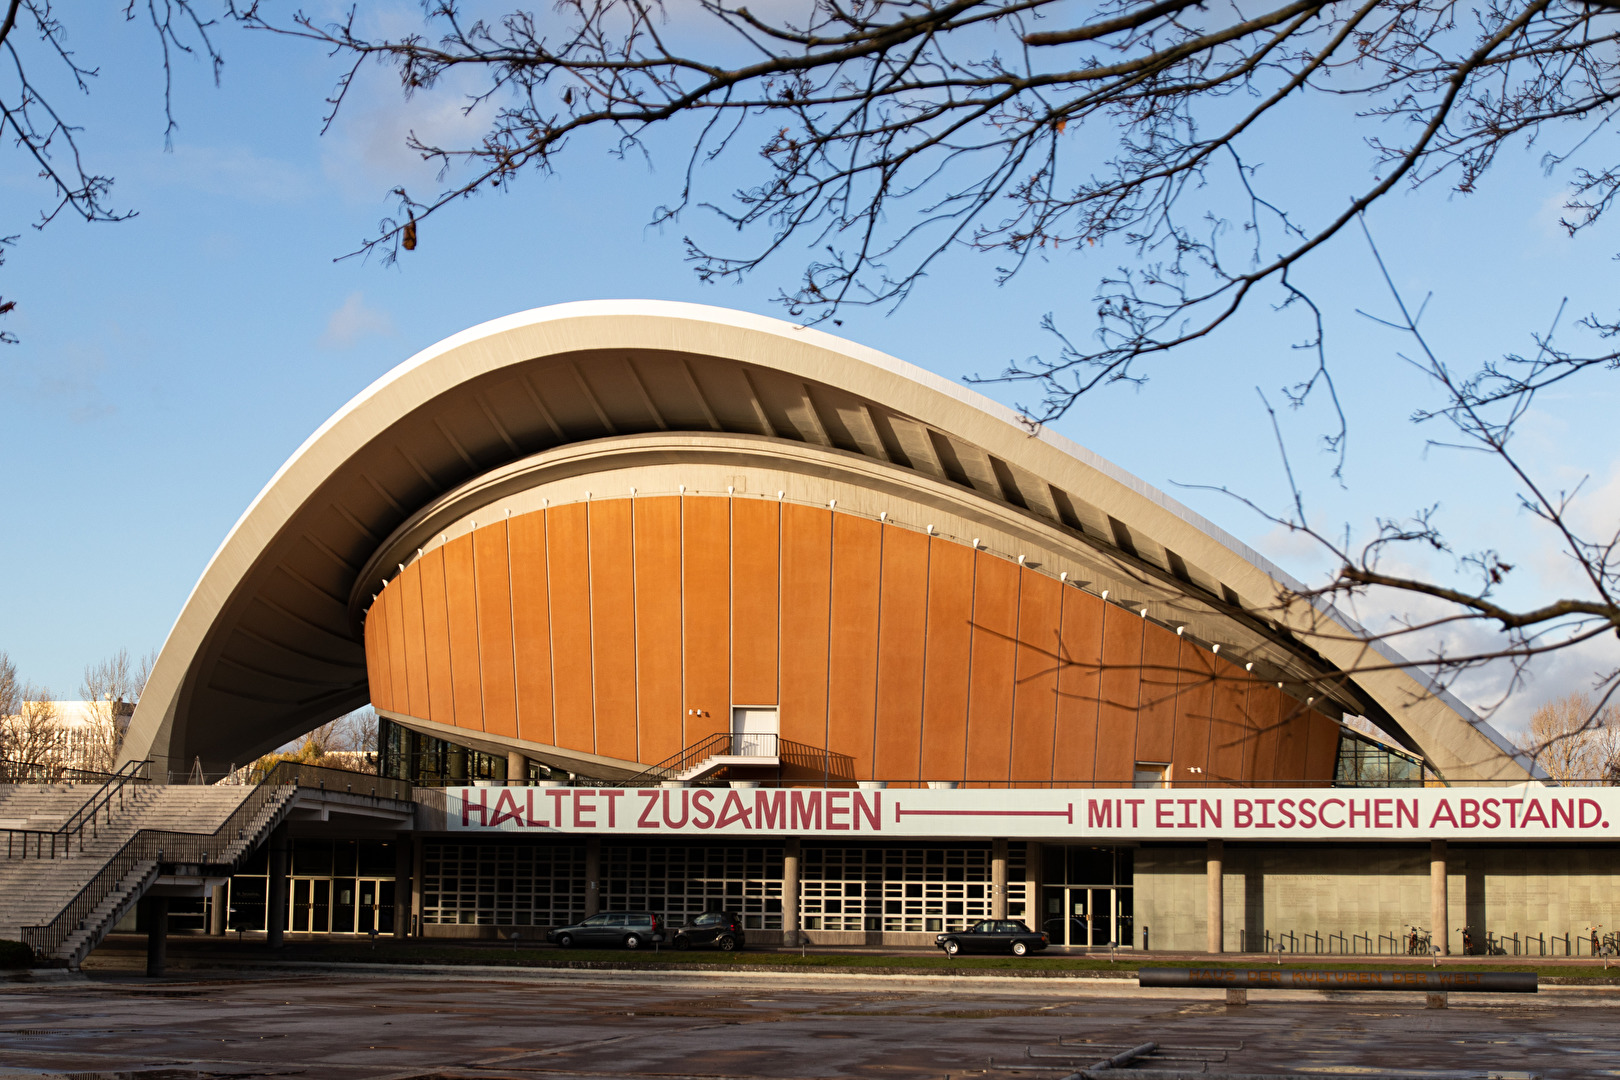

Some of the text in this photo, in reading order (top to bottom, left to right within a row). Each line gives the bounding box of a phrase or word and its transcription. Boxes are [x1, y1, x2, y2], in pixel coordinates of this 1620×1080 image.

[462, 788, 881, 831] HALTET ZUSAMMEN
[1087, 797, 1610, 829] MIT EIN BISSCHEN ABSTAND.
[1188, 969, 1485, 985] HAUS DER KULTUREN DER WELT
